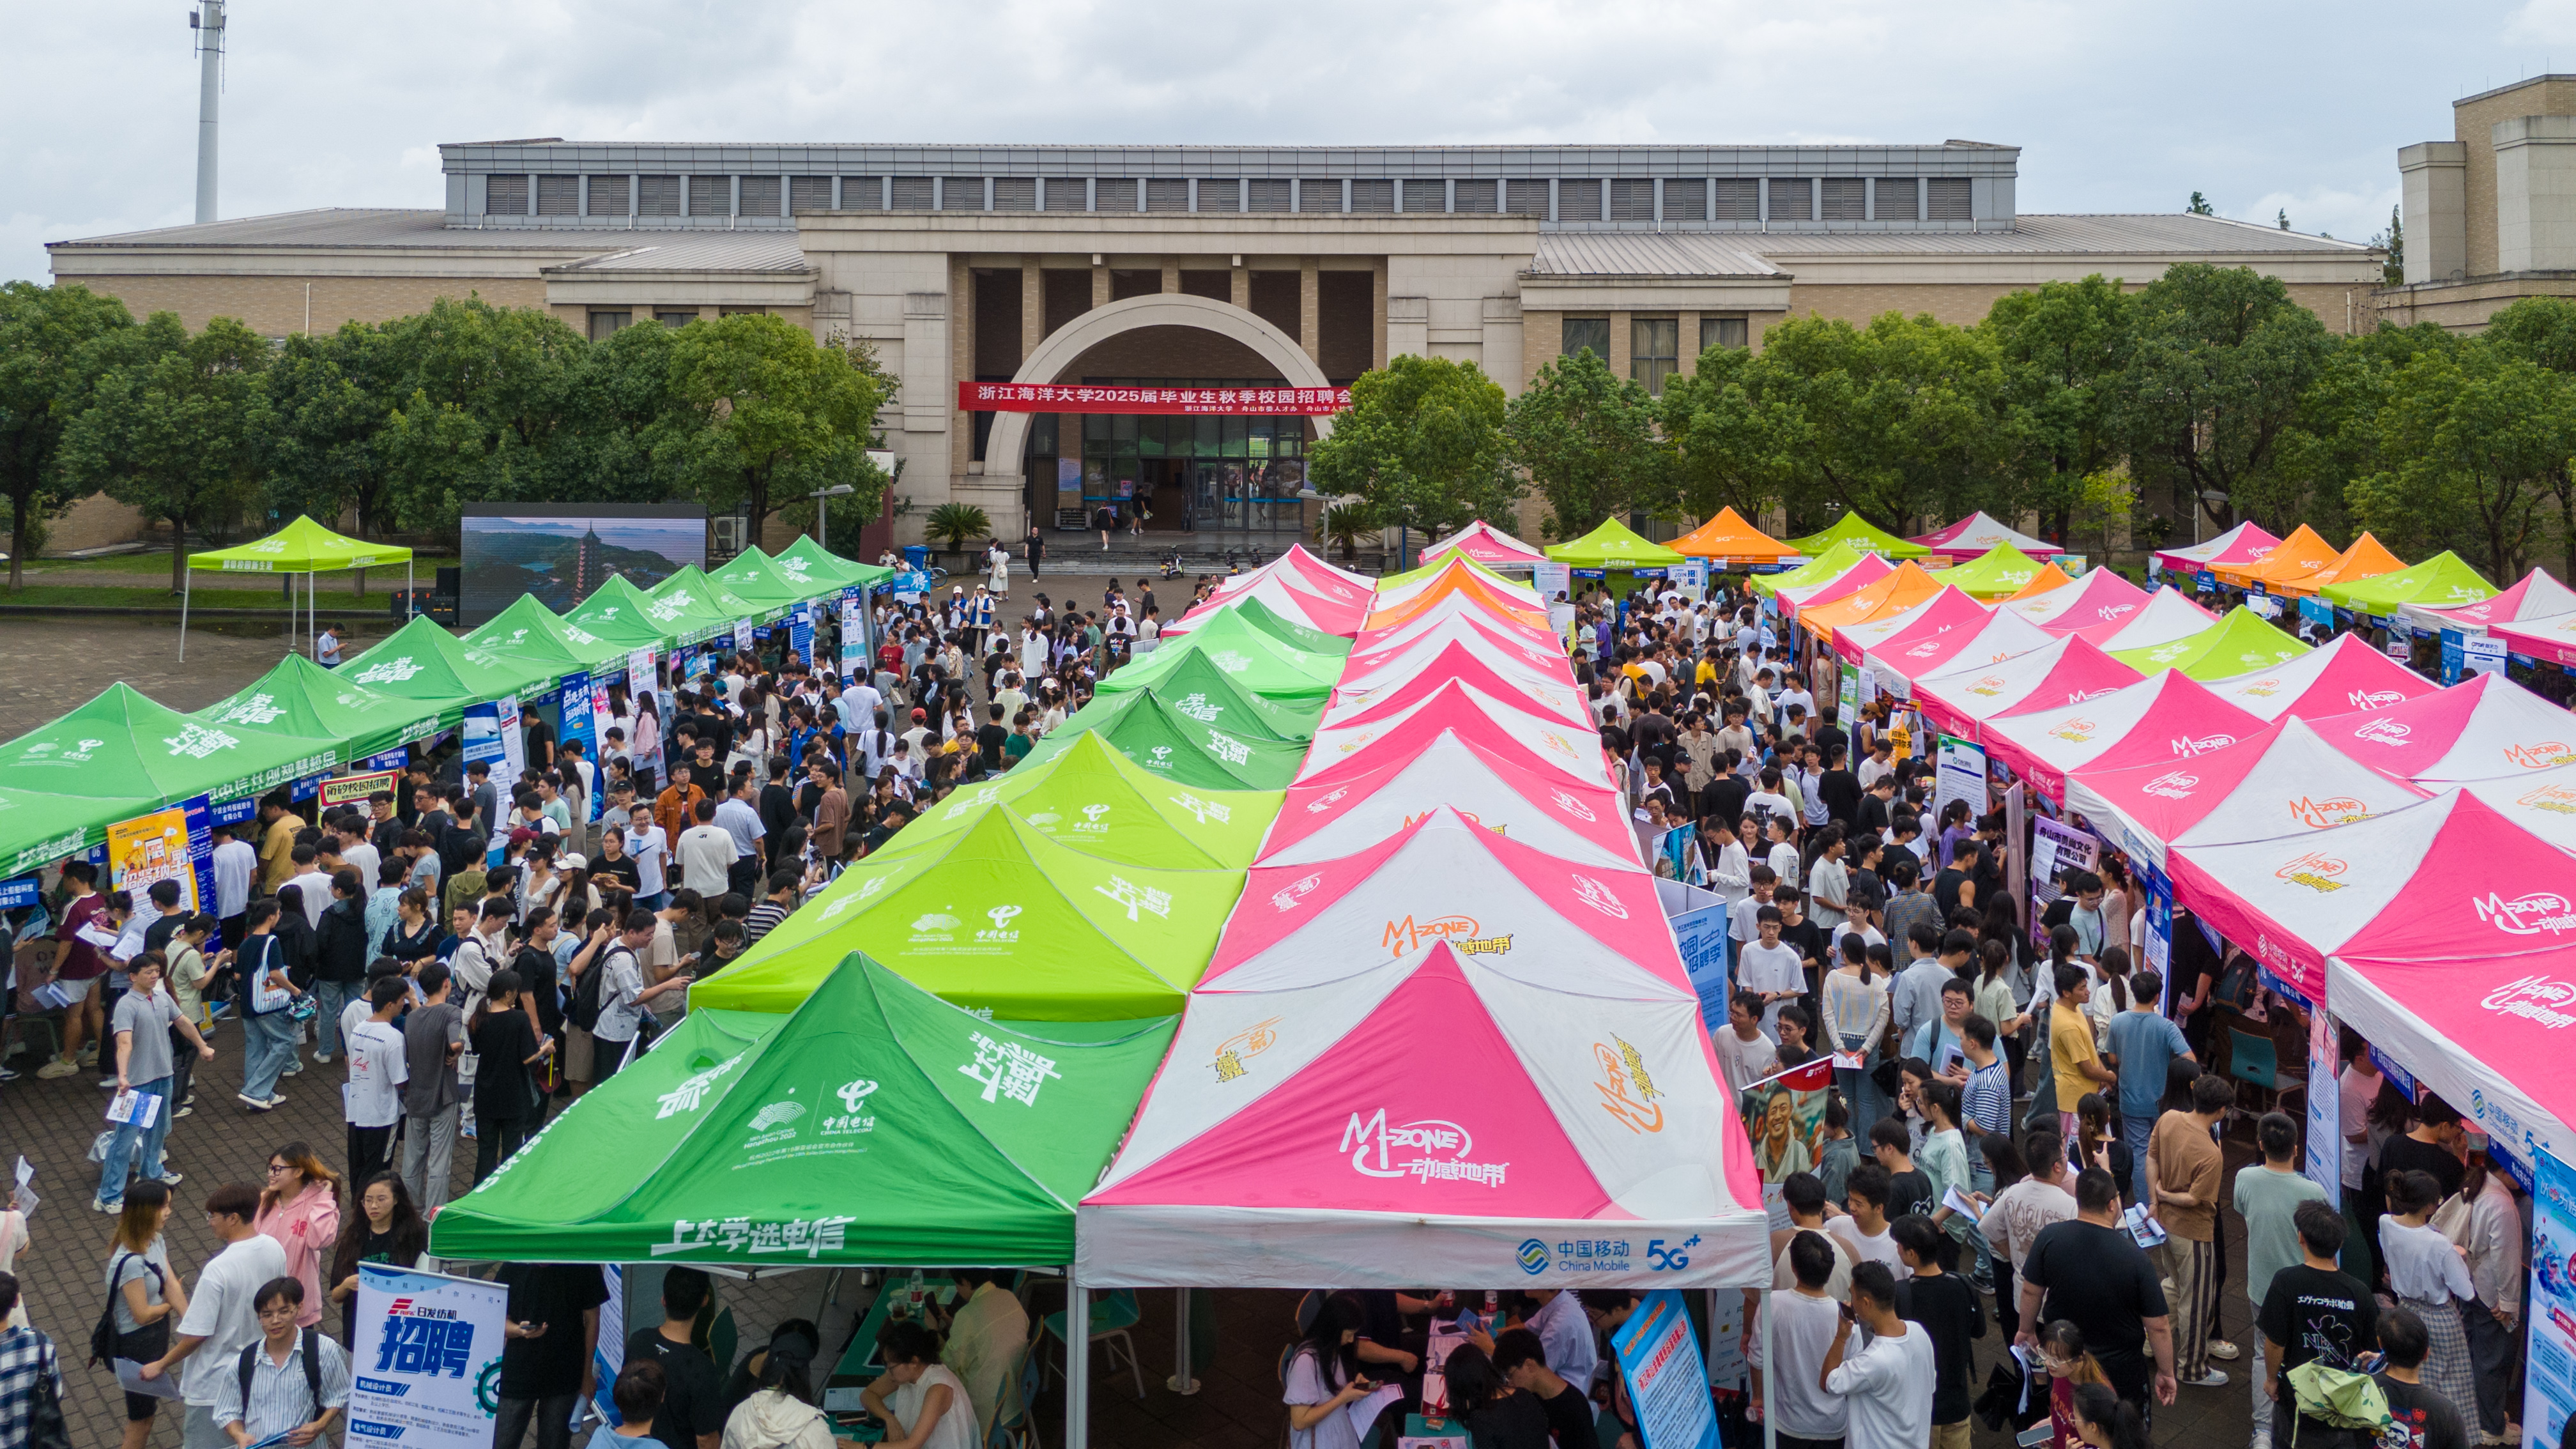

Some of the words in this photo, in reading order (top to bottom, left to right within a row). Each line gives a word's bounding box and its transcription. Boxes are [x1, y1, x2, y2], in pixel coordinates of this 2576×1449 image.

[978, 386, 1352, 404] 浙江海洋大学2025届毕业生秋季校园招聘会
[911, 572, 928, 590] 聘
[91, 847, 101, 857] 06
[122, 859, 188, 891] 招贤纳士
[2473, 892, 2571, 935] M-ZONE
[976, 930, 1019, 939] 中国电信
[1688, 942, 1721, 975] 招聘季
[823, 1116, 875, 1130] 中国电信
[744, 1136, 779, 1149] Hangzhou
[779, 1131, 797, 1140] 2022
[1339, 1108, 1472, 1177] M-ZONE
[1398, 1158, 1510, 1188] 动感地带
[651, 1216, 857, 1258] 上大学选电信
[1558, 1240, 1629, 1257] 中国移动
[1558, 1261, 1591, 1271] China
[1593, 1260, 1630, 1271] Mobile
[417, 1307, 457, 1320] 日发纺机
[374, 1315, 475, 1379] 招聘
[360, 1380, 392, 1393] 机械设计员
[354, 1423, 387, 1436] 电气设计员
